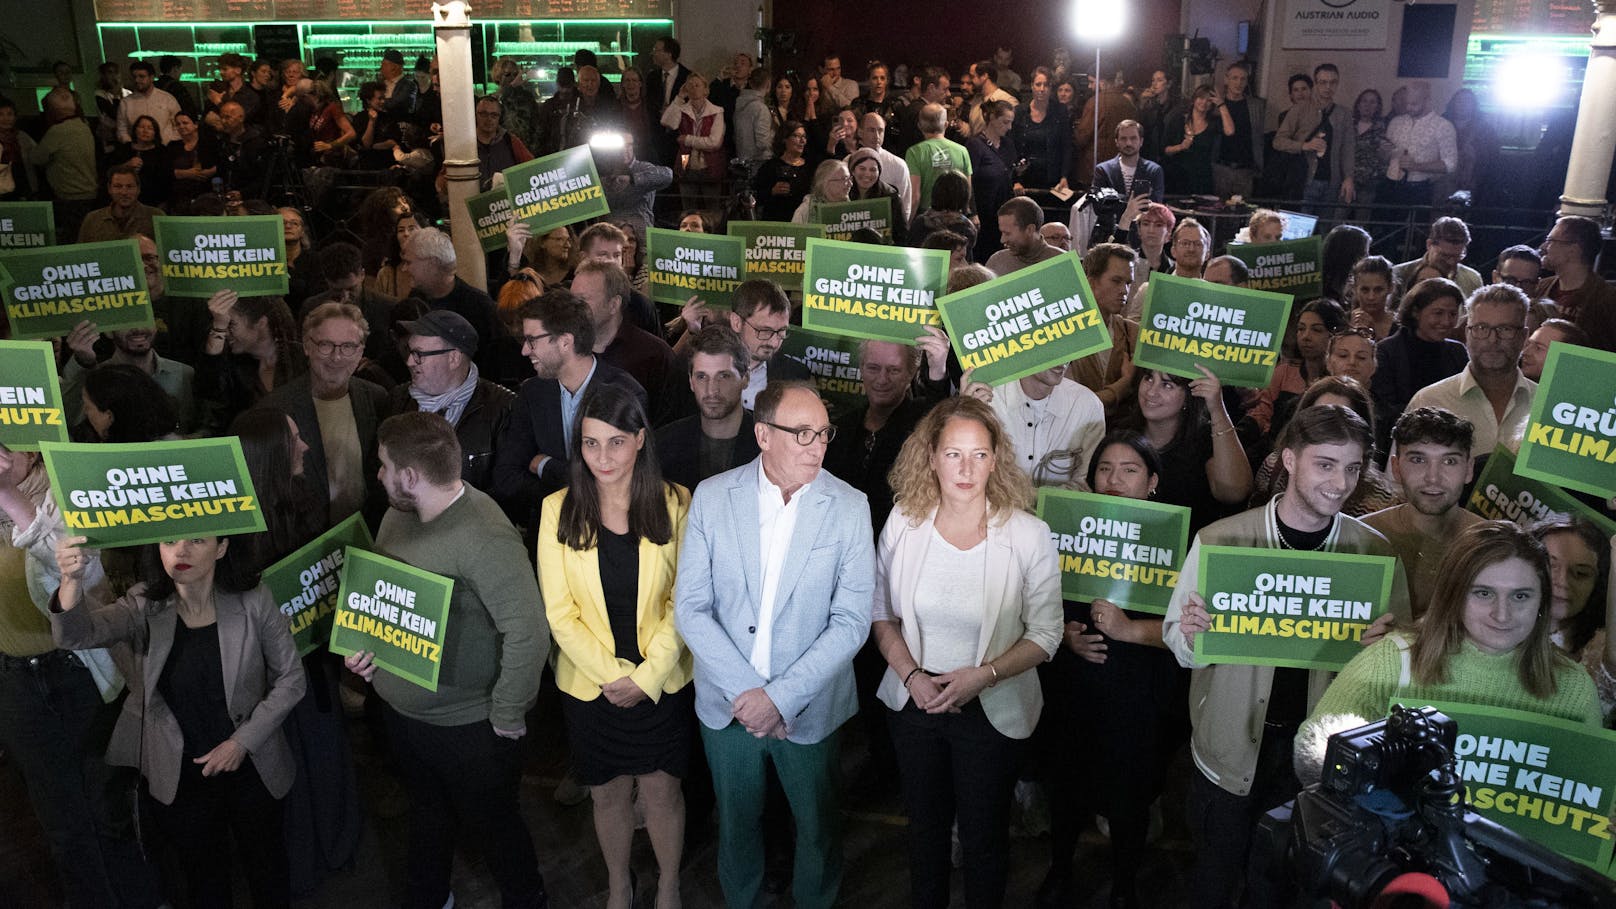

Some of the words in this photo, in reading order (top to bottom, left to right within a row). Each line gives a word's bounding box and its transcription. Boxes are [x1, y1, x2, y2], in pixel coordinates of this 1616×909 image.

[1295, 11, 1343, 20] AUSTRIAN
[1347, 11, 1380, 20] AUDIO
[514, 183, 559, 206] GRÜNE
[560, 174, 592, 193] KEIN
[529, 167, 567, 188] OHNE
[489, 199, 511, 212] OHN
[841, 211, 871, 222] OHNE
[478, 209, 513, 228] GRÜNE
[826, 219, 862, 233] GRÜNE
[862, 218, 887, 229] KEIN
[0, 233, 45, 247] KEIN
[194, 234, 246, 249] OHNE
[755, 235, 796, 248] OHNE
[168, 246, 231, 263] GRÜNE
[234, 248, 275, 262] KEIN
[675, 246, 714, 263] OHNE
[745, 246, 781, 260] RÜNE
[783, 249, 806, 261] KEI
[1256, 252, 1294, 267] OHNE
[41, 262, 101, 281] OHNE
[161, 262, 285, 278] KLIMASCHUTZ
[655, 258, 700, 276] GRÜNE
[702, 265, 738, 279] KEIN
[745, 261, 806, 273] IMASCHU
[847, 264, 905, 285] OHNE
[1247, 264, 1283, 279] RÜNE
[1284, 261, 1316, 275] KEIN
[14, 279, 86, 301] GRÜNE
[87, 275, 136, 294] KEIN
[815, 277, 884, 302] GRÜNE
[886, 286, 935, 306] KEIN
[1247, 271, 1322, 289] IMASCHUTZ
[7, 290, 149, 319] KLIMASCHUTZ
[805, 293, 941, 325] KLIMASCHUTZ
[985, 287, 1045, 323] OHNE
[1187, 301, 1246, 326] OHNE
[962, 314, 1033, 350] GRÜNE
[1032, 294, 1084, 326] KEIN
[1152, 312, 1222, 341] GRÜNE
[1224, 329, 1272, 348] KEIN
[960, 308, 1101, 370] KLIMASCHUTZ
[1139, 328, 1277, 366] KLIMASCHUTZ
[805, 345, 851, 365] OHNE
[835, 365, 862, 380] KEI
[1552, 401, 1616, 437] GRÜ
[106, 464, 187, 487] OHNE
[69, 485, 167, 509] GRÜNE
[170, 479, 238, 501] KEIN
[1518, 490, 1556, 520] OH
[63, 495, 257, 529] KLIMASCHUTZ
[1485, 484, 1532, 530] GRÜN
[1080, 516, 1141, 541] OHNE
[1121, 542, 1173, 566] KEIN
[299, 548, 344, 587] OHNE
[1058, 554, 1181, 588] IMASCHUTZ
[280, 573, 338, 617] GRÜNE
[375, 579, 417, 609] OHNE
[1255, 572, 1332, 596] OHNE
[347, 591, 399, 624] GRÜNE
[400, 605, 437, 640] KEIN
[1211, 588, 1303, 616] GRÜNE
[1308, 598, 1373, 620] KEIN
[335, 608, 441, 664] KLIMASCHUTZ
[1208, 613, 1372, 642] LIMASCHUT
[1454, 733, 1550, 768] OHNE
[1514, 768, 1603, 809] KEIN
[1450, 786, 1612, 841] SCHUTZ
